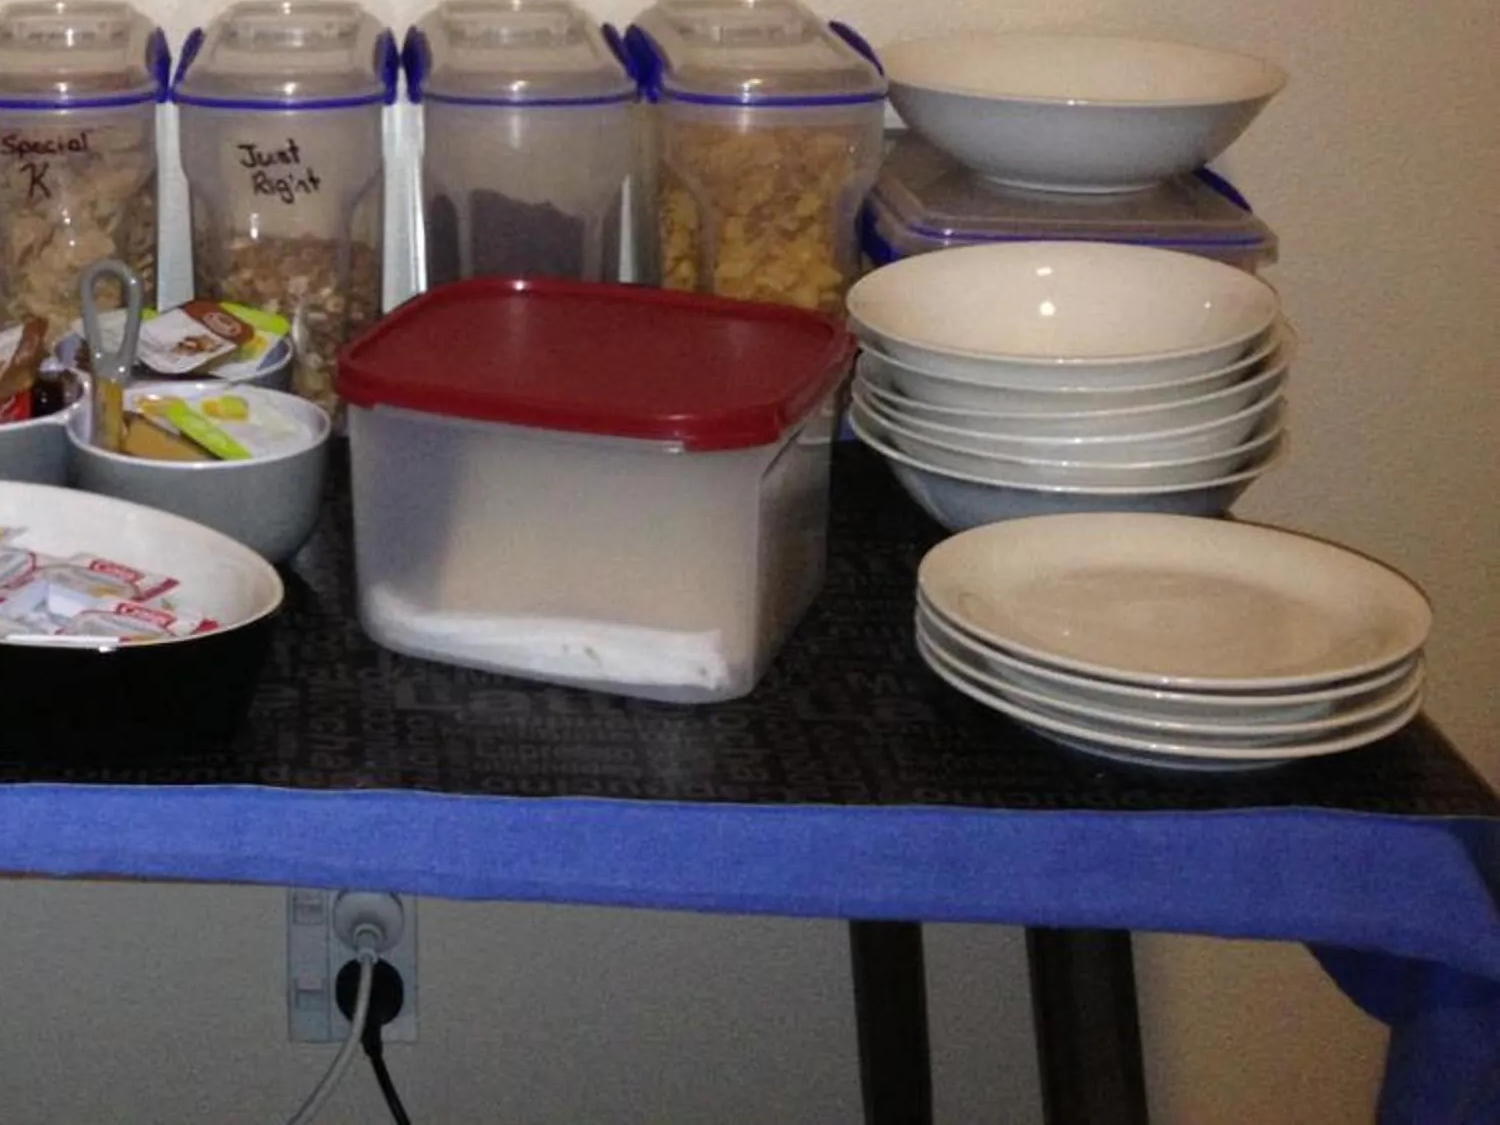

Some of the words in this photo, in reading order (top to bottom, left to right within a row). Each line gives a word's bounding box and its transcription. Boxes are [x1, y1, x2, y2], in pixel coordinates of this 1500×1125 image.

[0, 130, 89, 159] Special
[237, 137, 301, 168] Just
[20, 161, 52, 199] K
[251, 167, 321, 205] Right
